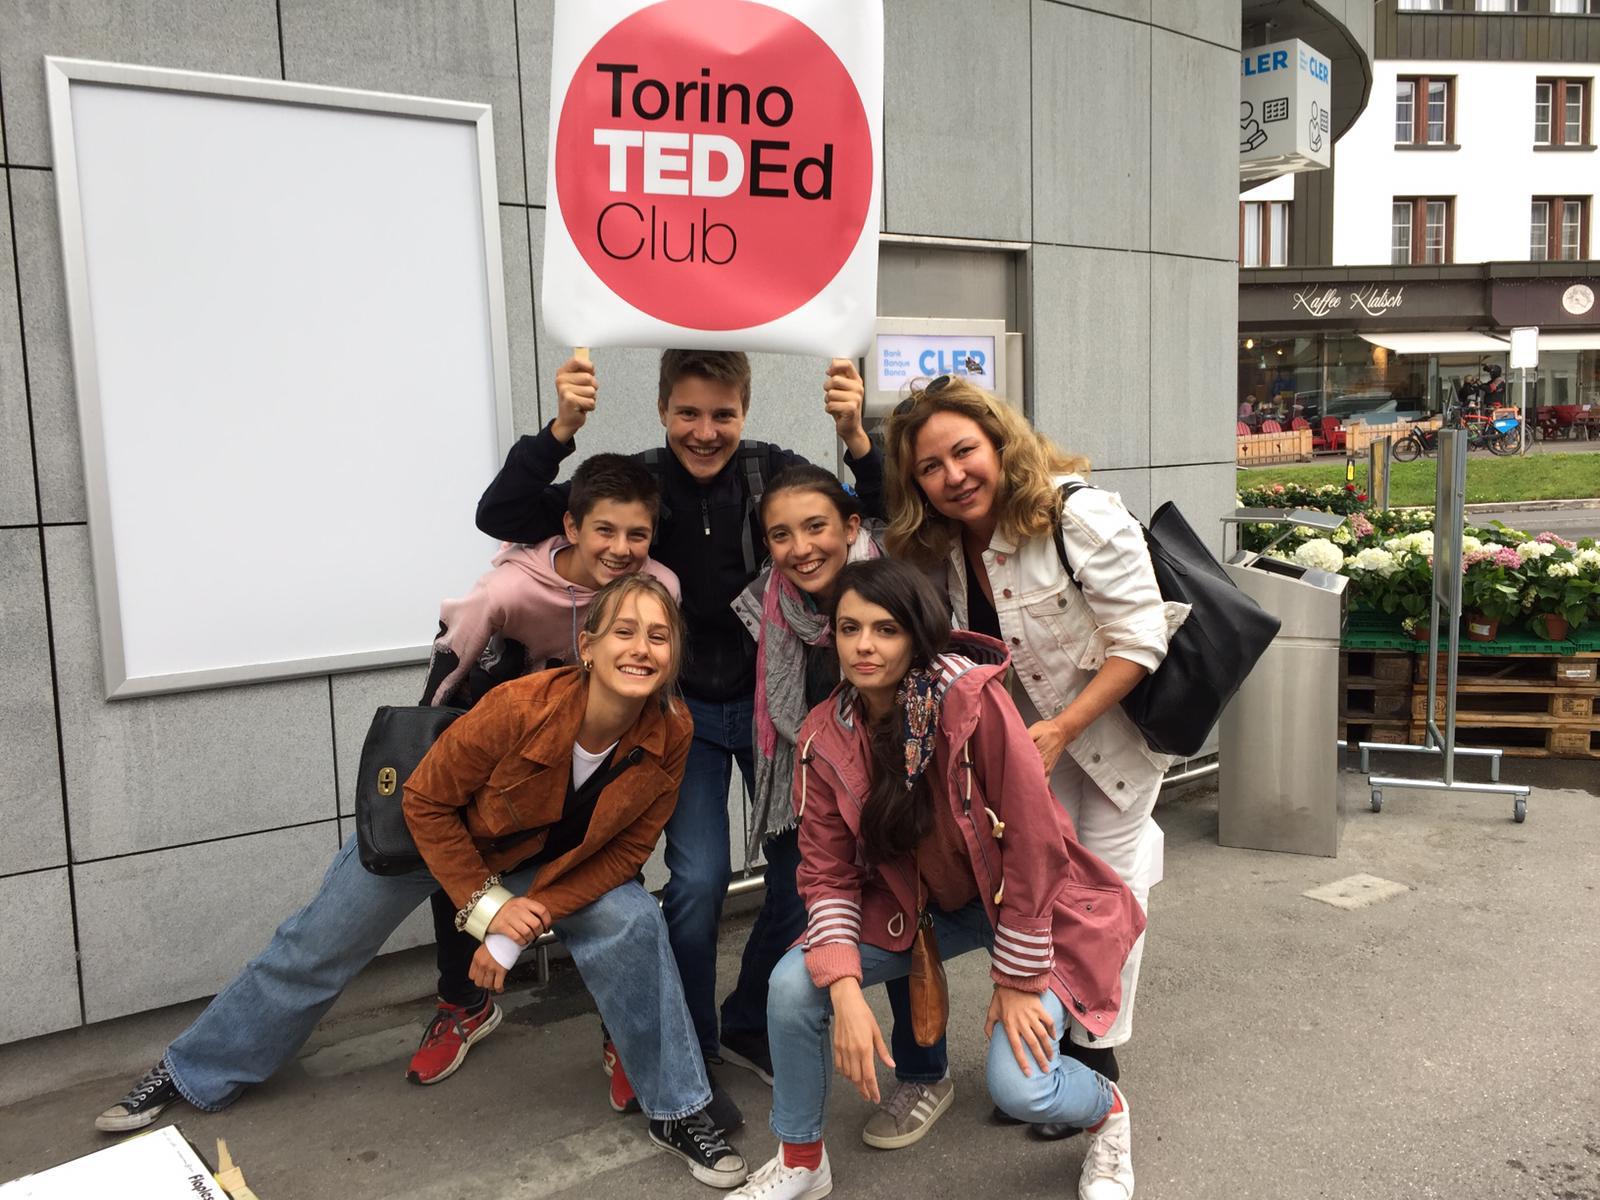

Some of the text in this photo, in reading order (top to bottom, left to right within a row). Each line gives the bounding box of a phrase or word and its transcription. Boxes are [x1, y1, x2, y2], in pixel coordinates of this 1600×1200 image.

[1241, 50, 1288, 76] LER
[1309, 56, 1329, 84] CLER
[596, 63, 794, 127] Torino
[596, 202, 737, 265] Club
[1292, 283, 1404, 316] Kaffee Klatsch
[883, 349, 901, 357] Bank
[883, 359, 910, 368] Banque
